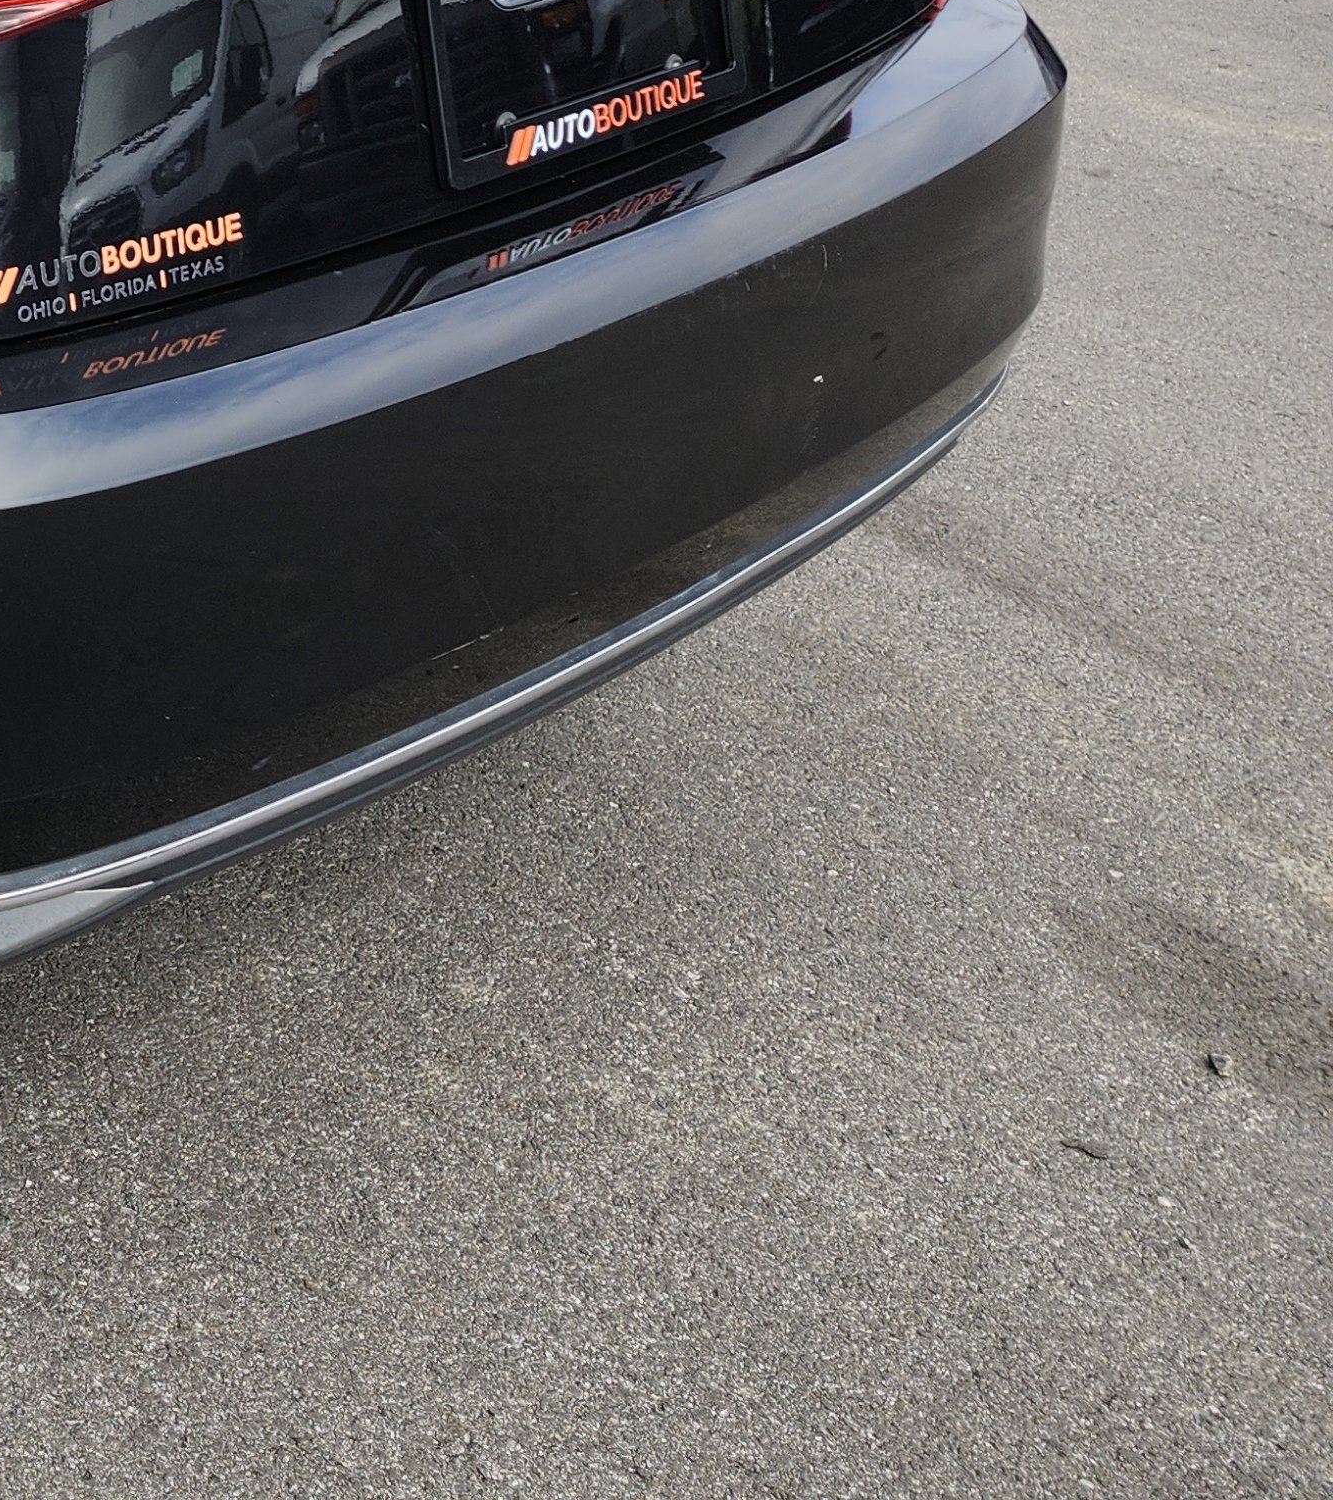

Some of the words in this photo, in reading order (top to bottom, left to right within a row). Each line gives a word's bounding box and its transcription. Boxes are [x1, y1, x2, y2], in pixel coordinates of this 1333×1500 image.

[530, 69, 705, 157] AUTOBOUTIQUE
[15, 212, 244, 295] AUTOBOUTIQUE
[17, 297, 66, 323] OHIO
[82, 274, 157, 308] FLORIDA
[170, 255, 225, 285] TEXAS
